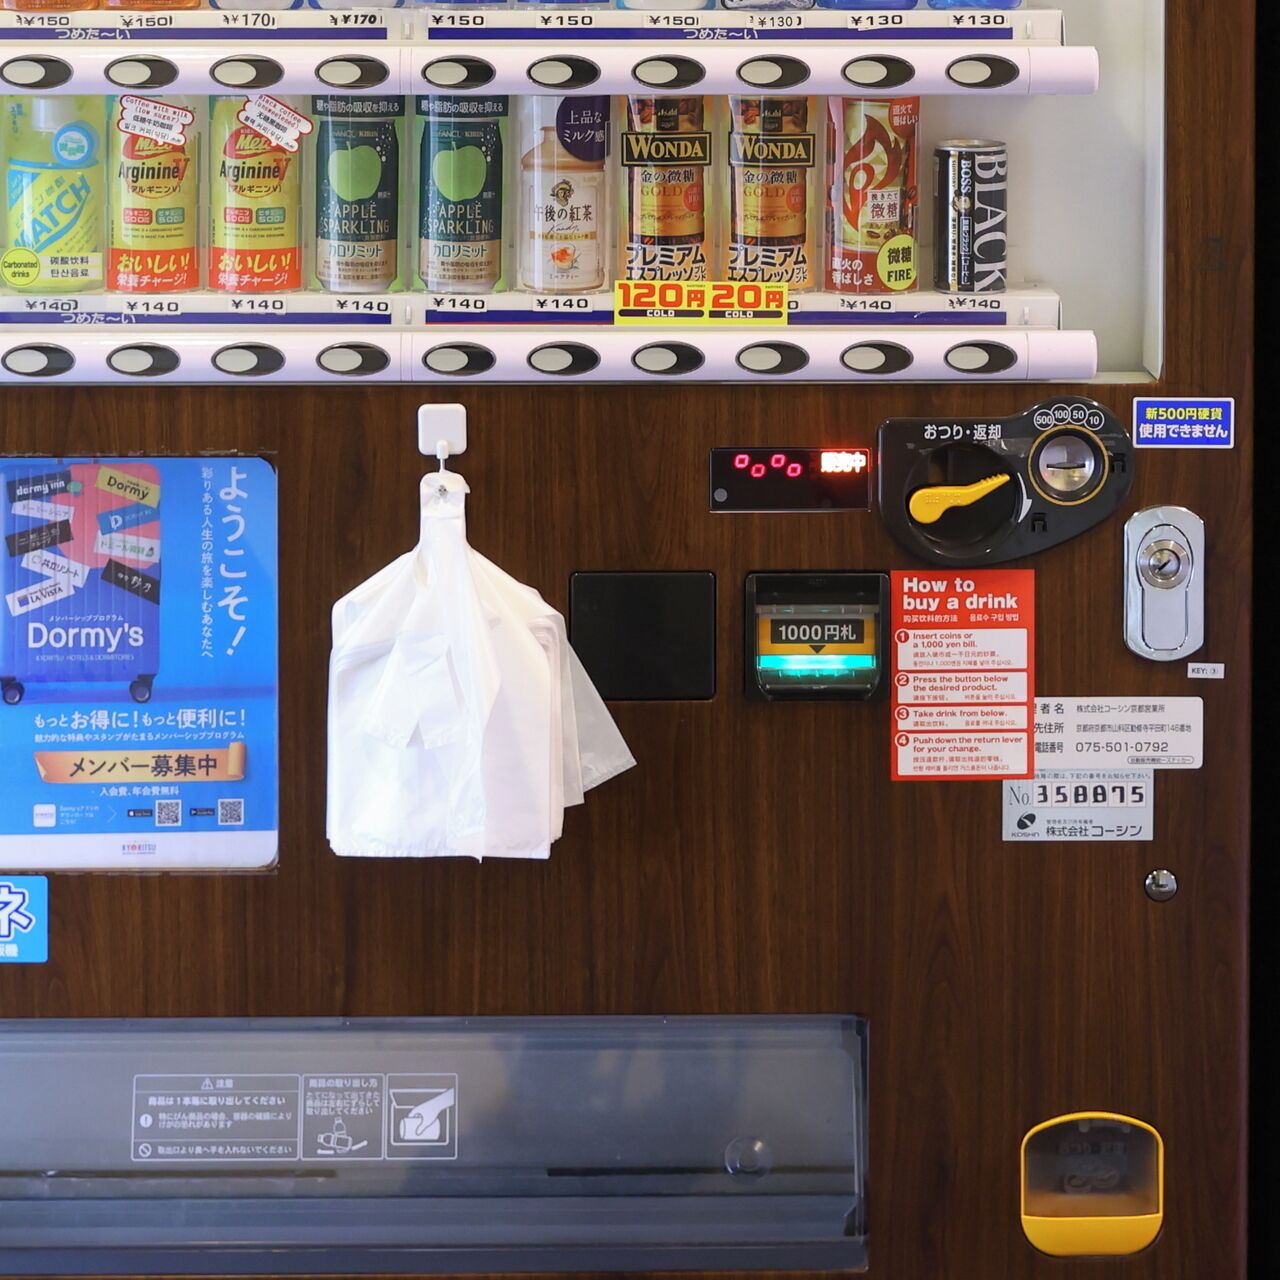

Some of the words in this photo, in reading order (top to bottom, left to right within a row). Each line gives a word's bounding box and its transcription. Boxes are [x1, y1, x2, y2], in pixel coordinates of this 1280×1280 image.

[432, 15, 485, 26] ¥150
[541, 16, 593, 26] ¥150
[628, 135, 705, 159] WONDA
[961, 160, 972, 193] BOSS
[334, 204, 377, 218] APPLE
[439, 204, 482, 219] APPLE
[324, 219, 390, 234] SPARKLING
[427, 219, 494, 234] SPARKLING
[974, 152, 1007, 292] BLACK
[626, 245, 706, 267] プレミアム
[728, 246, 807, 267] プレミアム
[888, 247, 912, 265] 微糖
[117, 254, 190, 274] おいしい!
[887, 270, 912, 282] FIRE
[1036, 416, 1052, 425] 500
[1054, 410, 1069, 419] 100
[1072, 410, 1084, 419] 50
[1089, 416, 1098, 425] 10
[1145, 407, 1222, 420] 新500円硬貨
[1139, 423, 1228, 438] 使用できません
[106, 475, 150, 501] Dormy
[902, 577, 947, 593] How
[954, 578, 975, 593] to
[902, 595, 940, 611] buy
[947, 598, 959, 609] a
[965, 593, 1018, 609] drink
[903, 614, 958, 622] 购买饮料的方法
[28, 622, 144, 653] Dormy's
[778, 625, 856, 641] 1000円札
[921, 641, 943, 649] 1,000
[946, 641, 961, 649] yen
[963, 640, 978, 648] bill.
[955, 675, 981, 683] button
[962, 684, 997, 692] product.
[913, 745, 924, 753] for
[948, 745, 981, 753] change.
[69, 754, 217, 777] メンバー募集中
[1046, 826, 1142, 838] 株式会社コーシン
[309, 1078, 378, 1088] 商品の取り出し方
